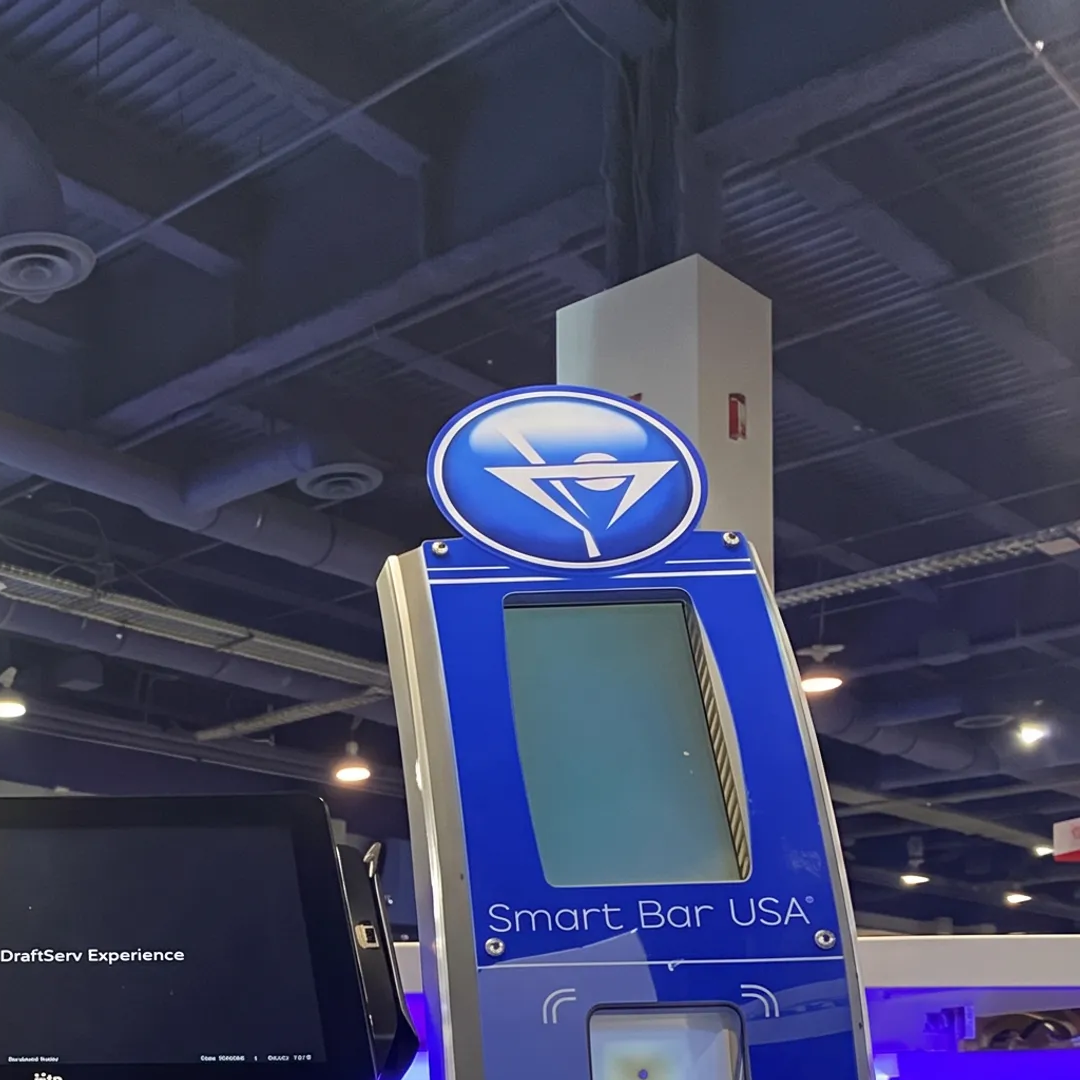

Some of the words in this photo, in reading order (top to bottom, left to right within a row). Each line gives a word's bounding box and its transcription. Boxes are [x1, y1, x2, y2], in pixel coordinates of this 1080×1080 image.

[489, 901, 623, 933] Smart
[638, 899, 714, 930] Bar
[729, 897, 811, 926] USA
[0, 949, 83, 963] DraftServ
[88, 948, 185, 964] Experience
